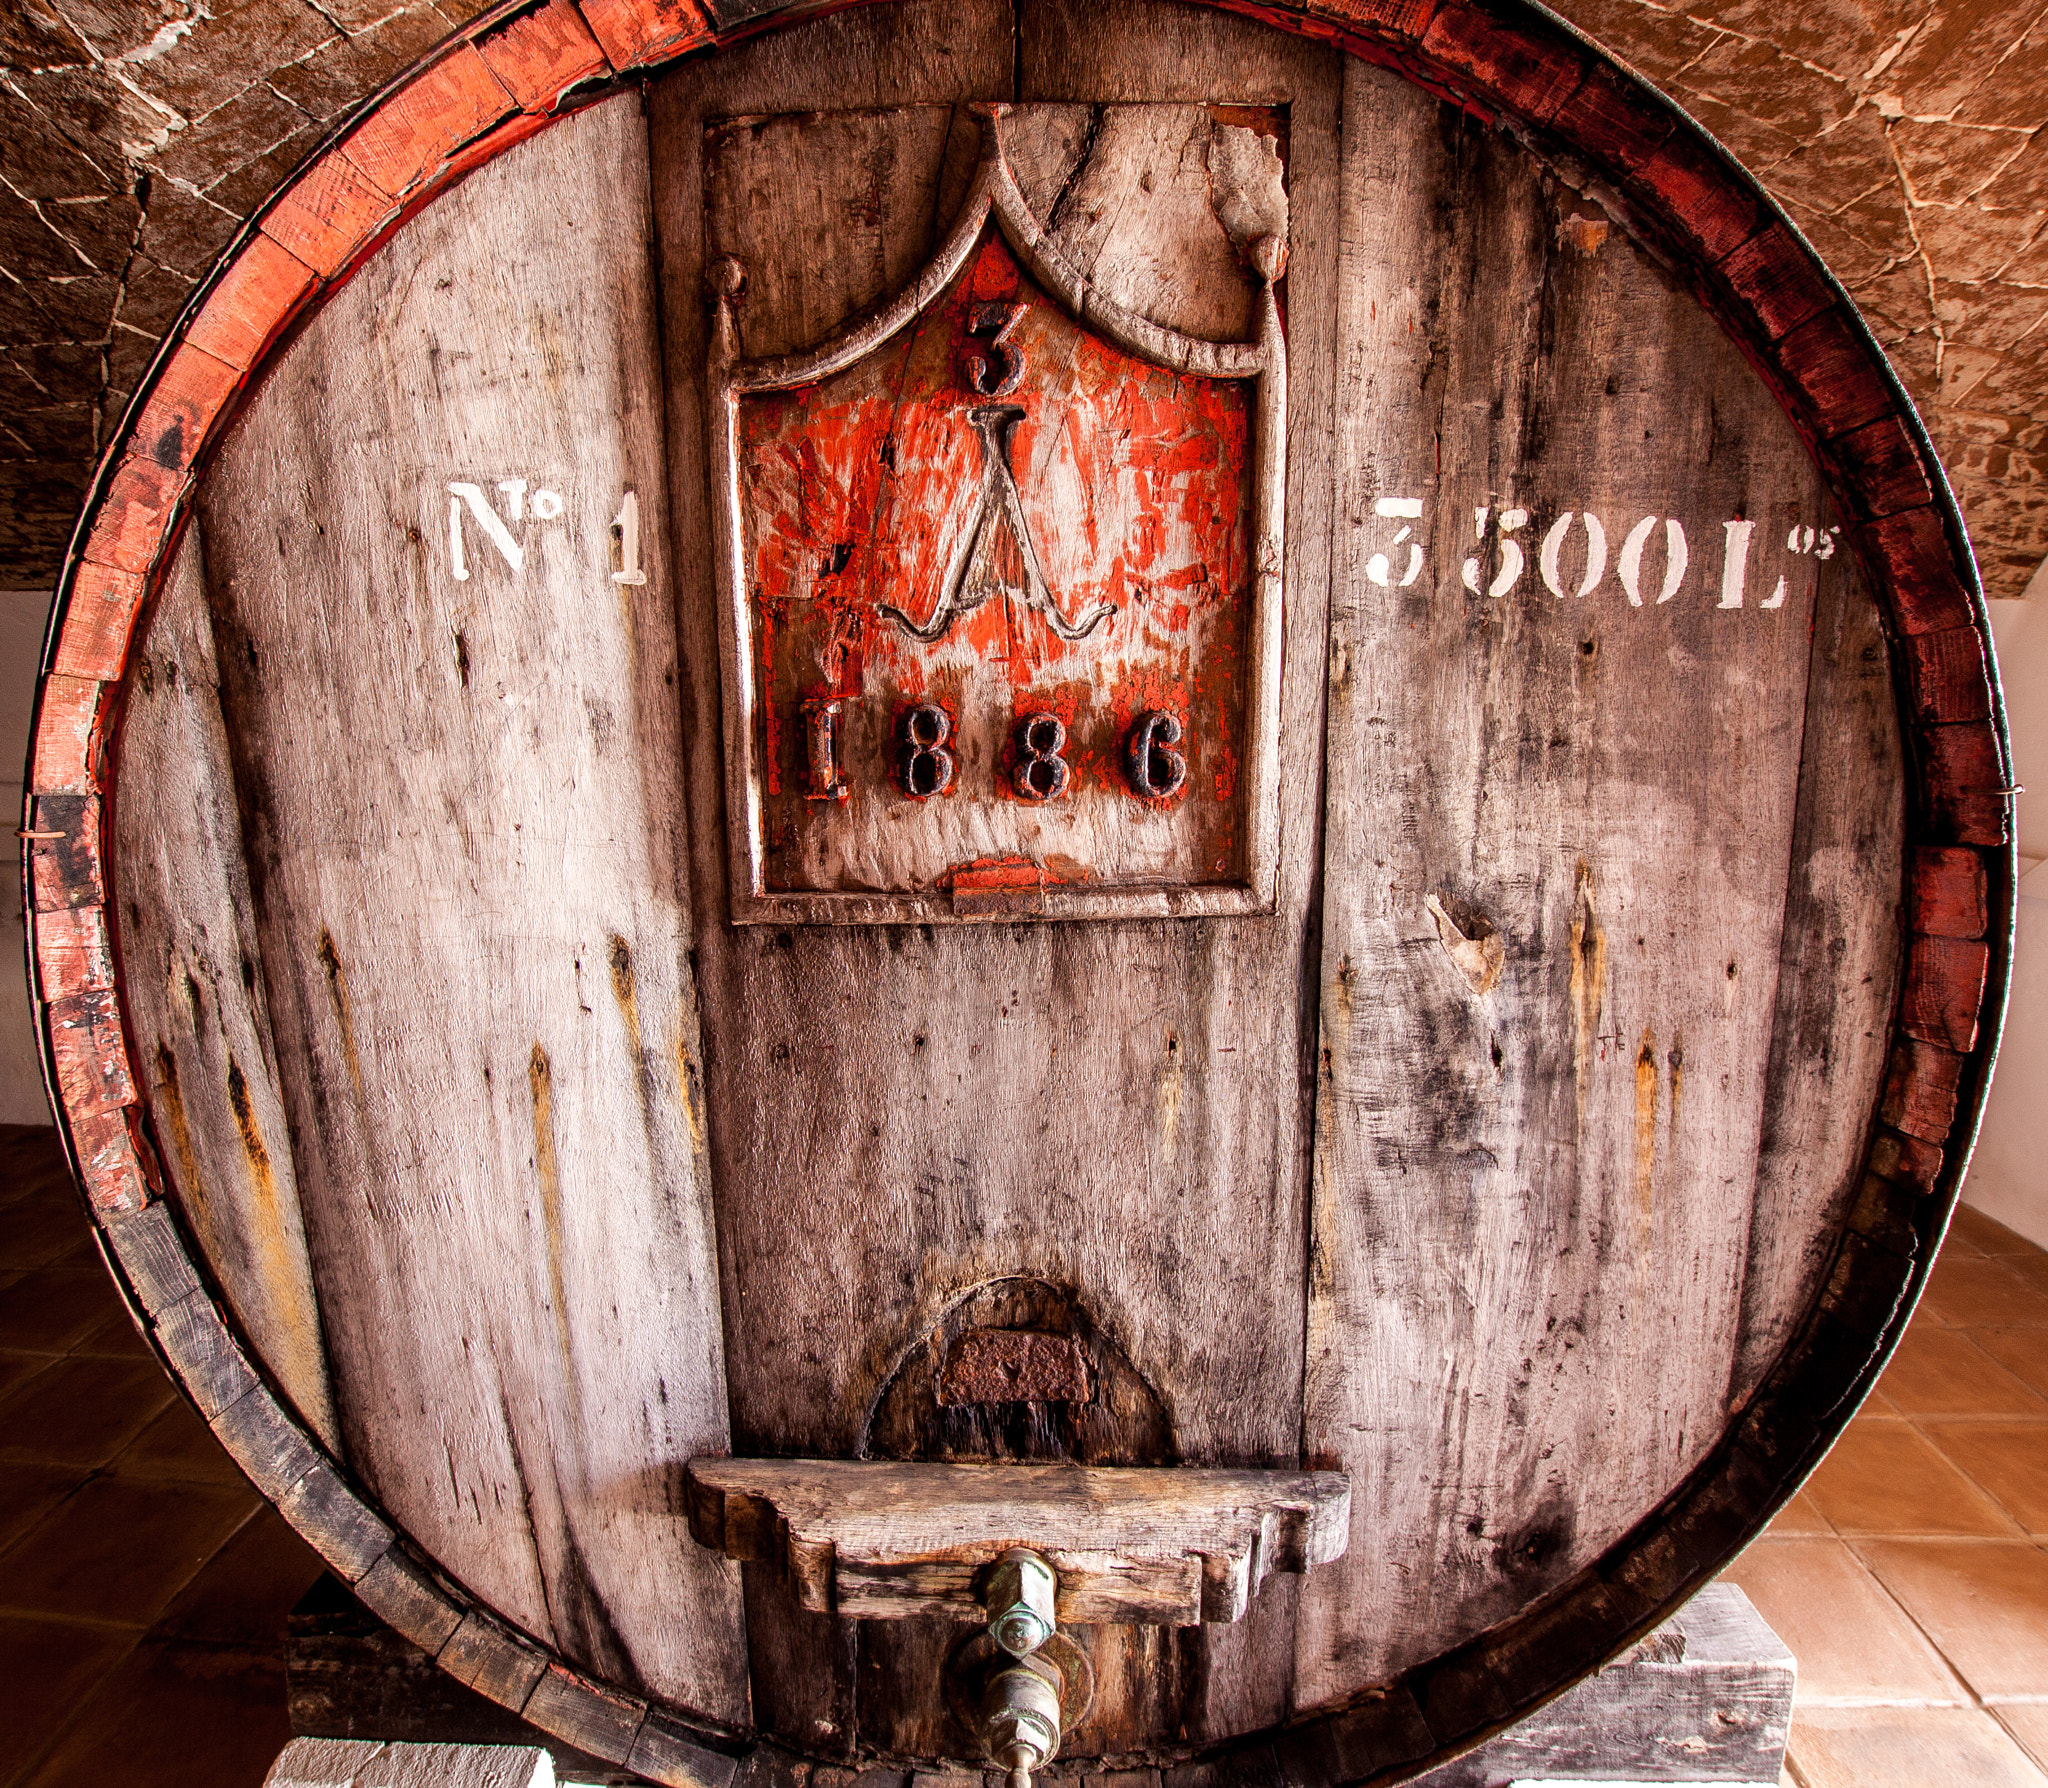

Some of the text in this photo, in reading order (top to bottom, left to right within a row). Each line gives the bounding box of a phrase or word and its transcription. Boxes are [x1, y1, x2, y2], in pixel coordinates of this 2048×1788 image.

[965, 302, 1027, 396] 3
[608, 490, 648, 586] 1
[803, 700, 1187, 801] 1886
